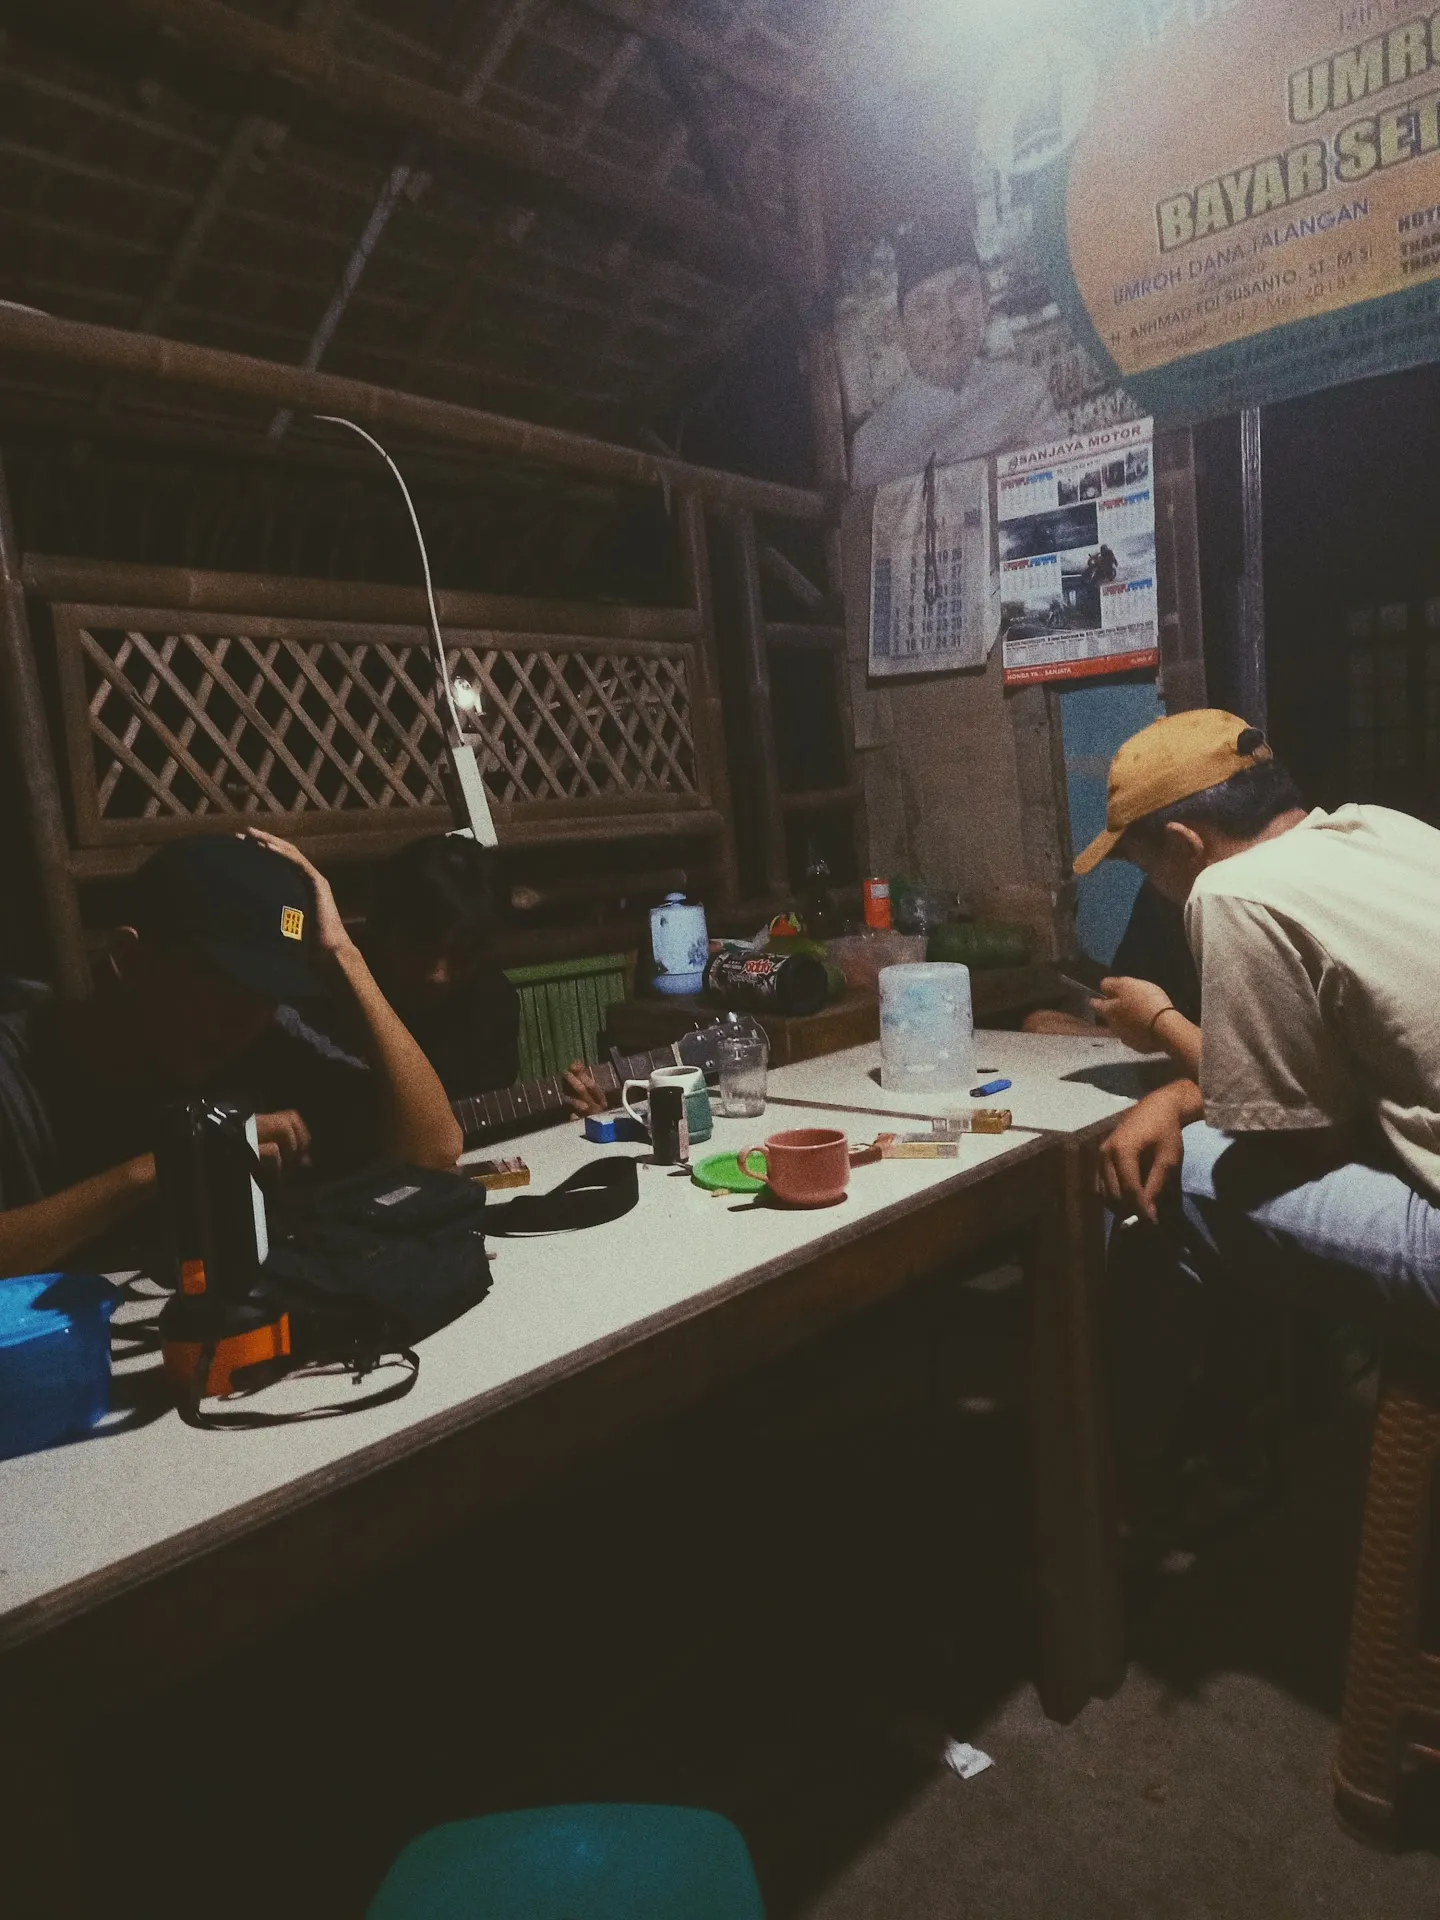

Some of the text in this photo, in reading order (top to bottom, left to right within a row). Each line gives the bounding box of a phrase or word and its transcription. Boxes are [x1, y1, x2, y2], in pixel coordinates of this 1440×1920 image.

[1290, 10, 1440, 124] UMR
[1157, 139, 1327, 251] BAYAR
[1398, 206, 1440, 233] HOT
[1113, 267, 1181, 306] UMROH
[1189, 244, 1245, 279] DANA
[1248, 198, 1370, 253] TALANGAN
[1018, 424, 1142, 464] SANJAYA MOTOR
